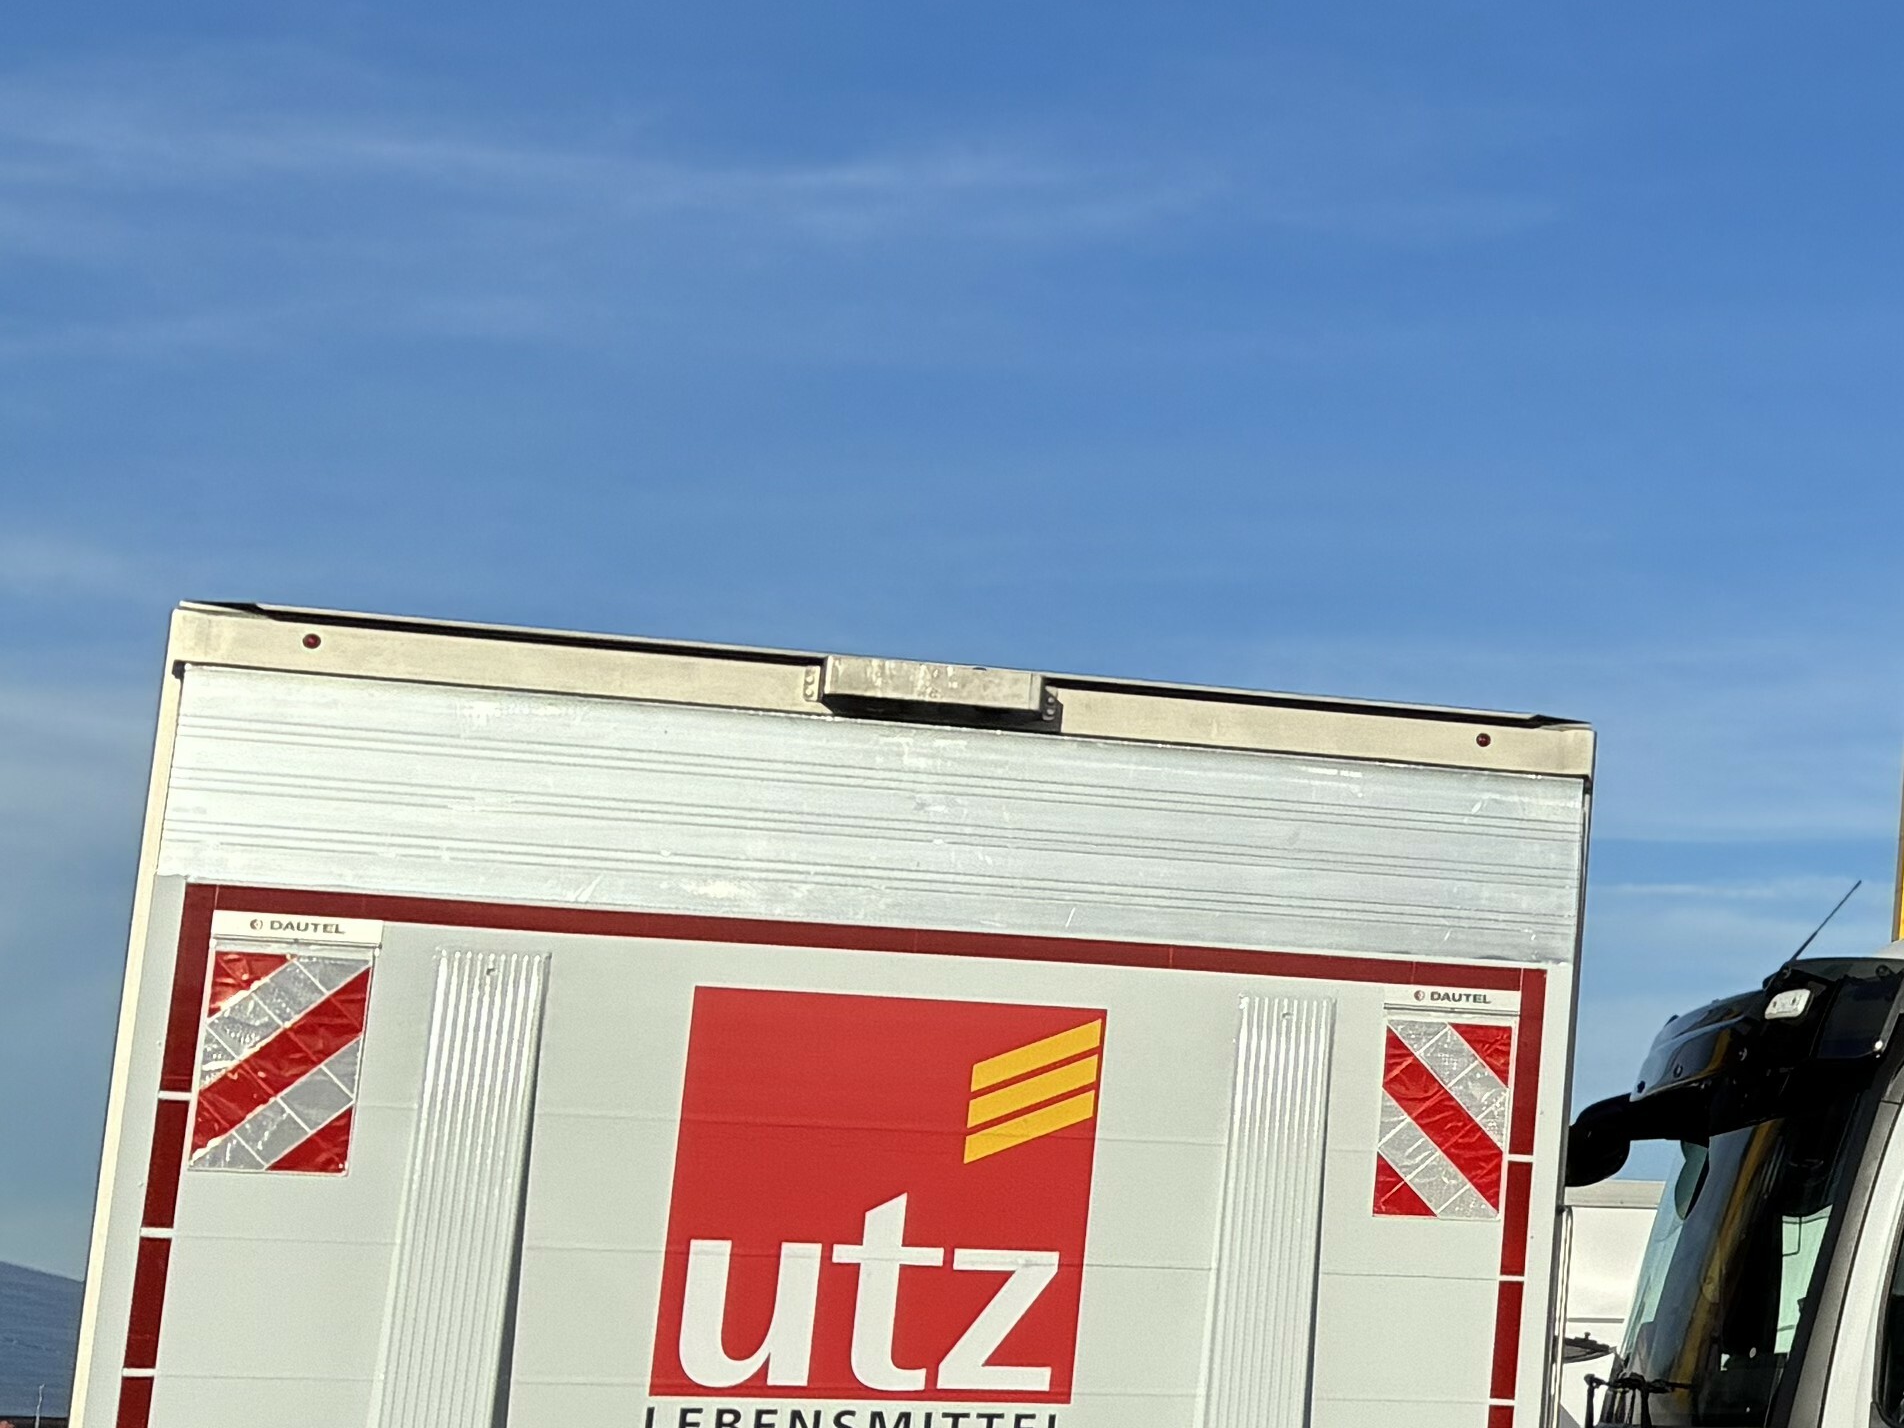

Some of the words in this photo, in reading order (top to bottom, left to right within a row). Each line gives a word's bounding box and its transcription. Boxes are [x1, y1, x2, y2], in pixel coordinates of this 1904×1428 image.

[270, 919, 347, 935] DAUTEL
[1429, 991, 1492, 1005] DAUTEL
[678, 1192, 1061, 1393] utz
